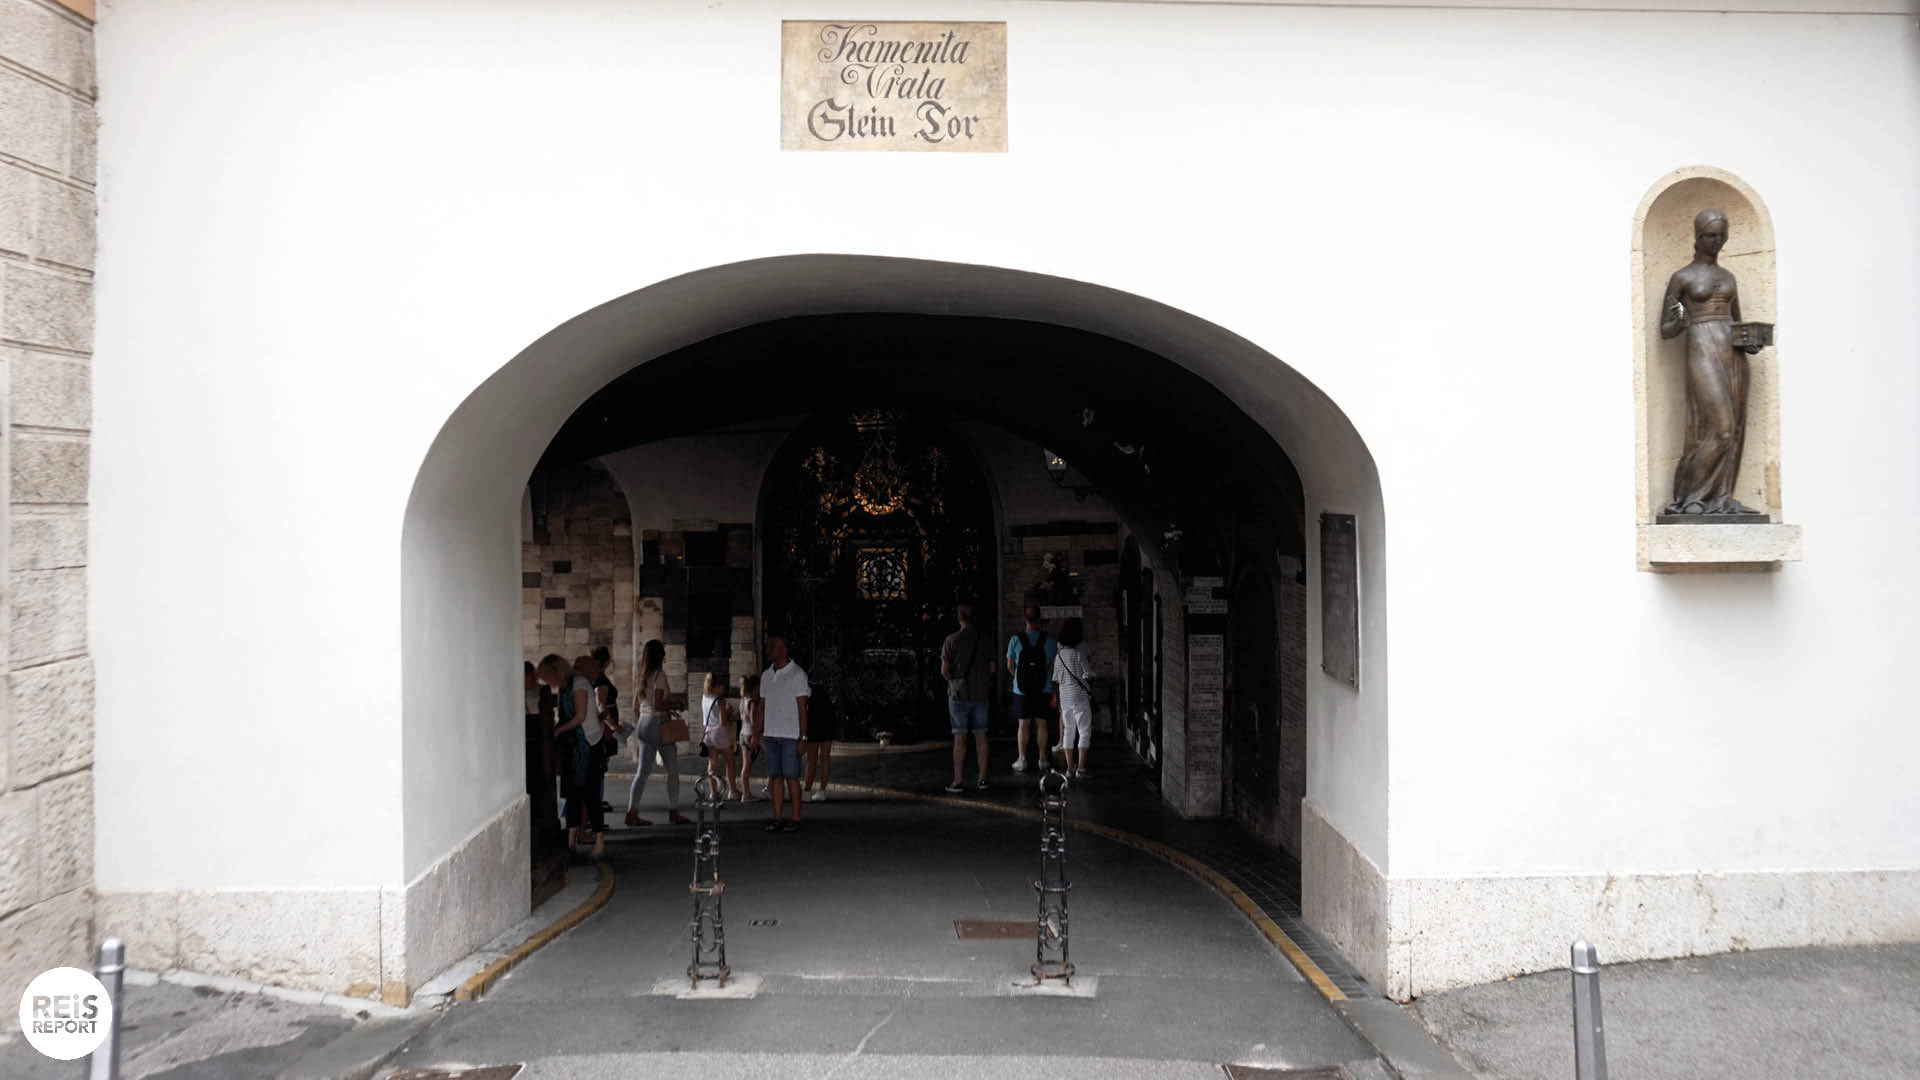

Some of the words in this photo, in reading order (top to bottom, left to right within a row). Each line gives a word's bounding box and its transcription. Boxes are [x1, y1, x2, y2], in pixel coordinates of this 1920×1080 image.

[818, 24, 969, 65] Kamenita
[841, 64, 946, 100] Vrata
[807, 97, 896, 142] Stein
[913, 100, 981, 144] Tor
